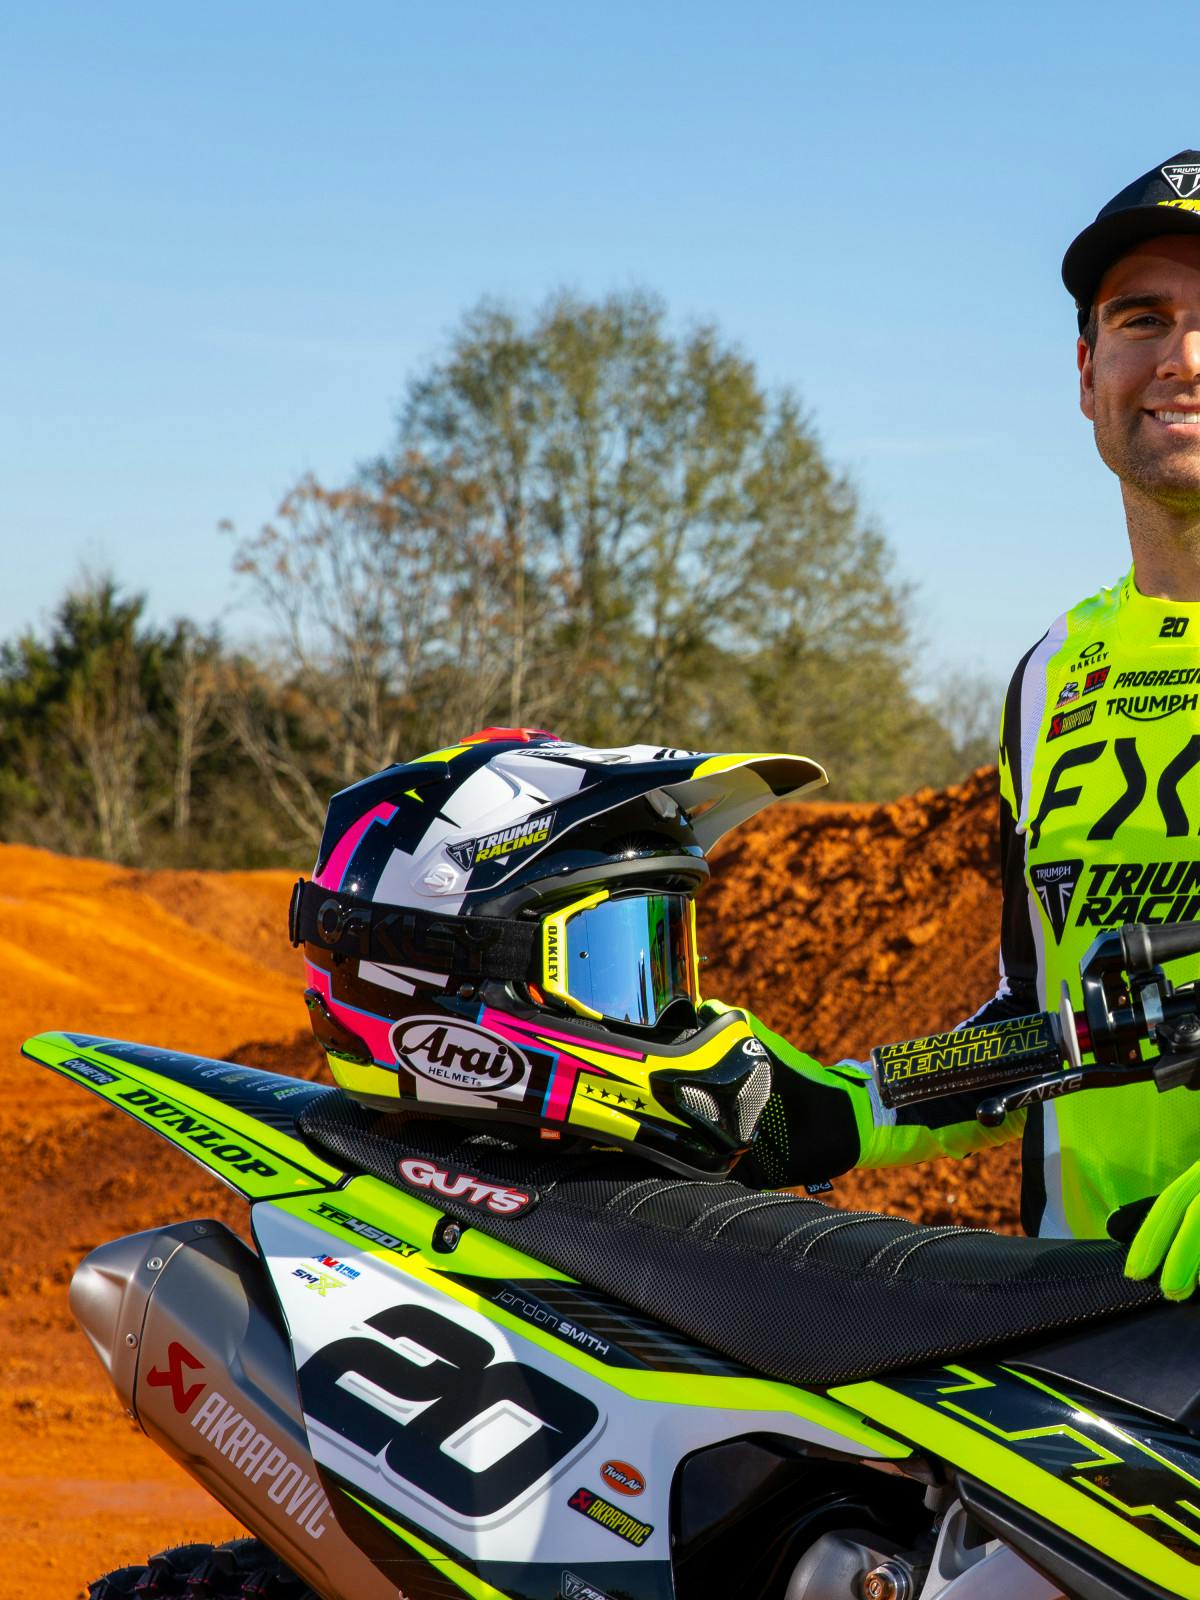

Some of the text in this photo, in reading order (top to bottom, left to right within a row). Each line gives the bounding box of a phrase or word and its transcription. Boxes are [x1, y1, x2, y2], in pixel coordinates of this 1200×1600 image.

[1158, 616, 1190, 638] 20
[1070, 651, 1110, 673] OAKLEY
[1106, 693, 1198, 721] TRIUMPH
[475, 828, 549, 862] RACING
[477, 814, 551, 851] TRIUMPH
[1036, 865, 1072, 882] TRIUMPH
[547, 925, 559, 983] OAKLEY
[399, 1026, 510, 1078] Arai
[882, 1015, 1044, 1059] RENTHAL
[885, 1029, 1049, 1083] RENTHAL
[63, 1058, 115, 1084] COMETIC
[428, 1066, 480, 1086] HELMET
[116, 1088, 278, 1178] DUNLOP
[400, 1157, 530, 1214] GUTS
[312, 1203, 421, 1258] TF450X
[491, 1288, 610, 1356] jordon SMITH
[298, 1304, 599, 1518] 20
[604, 1463, 642, 1491] Twin Air
